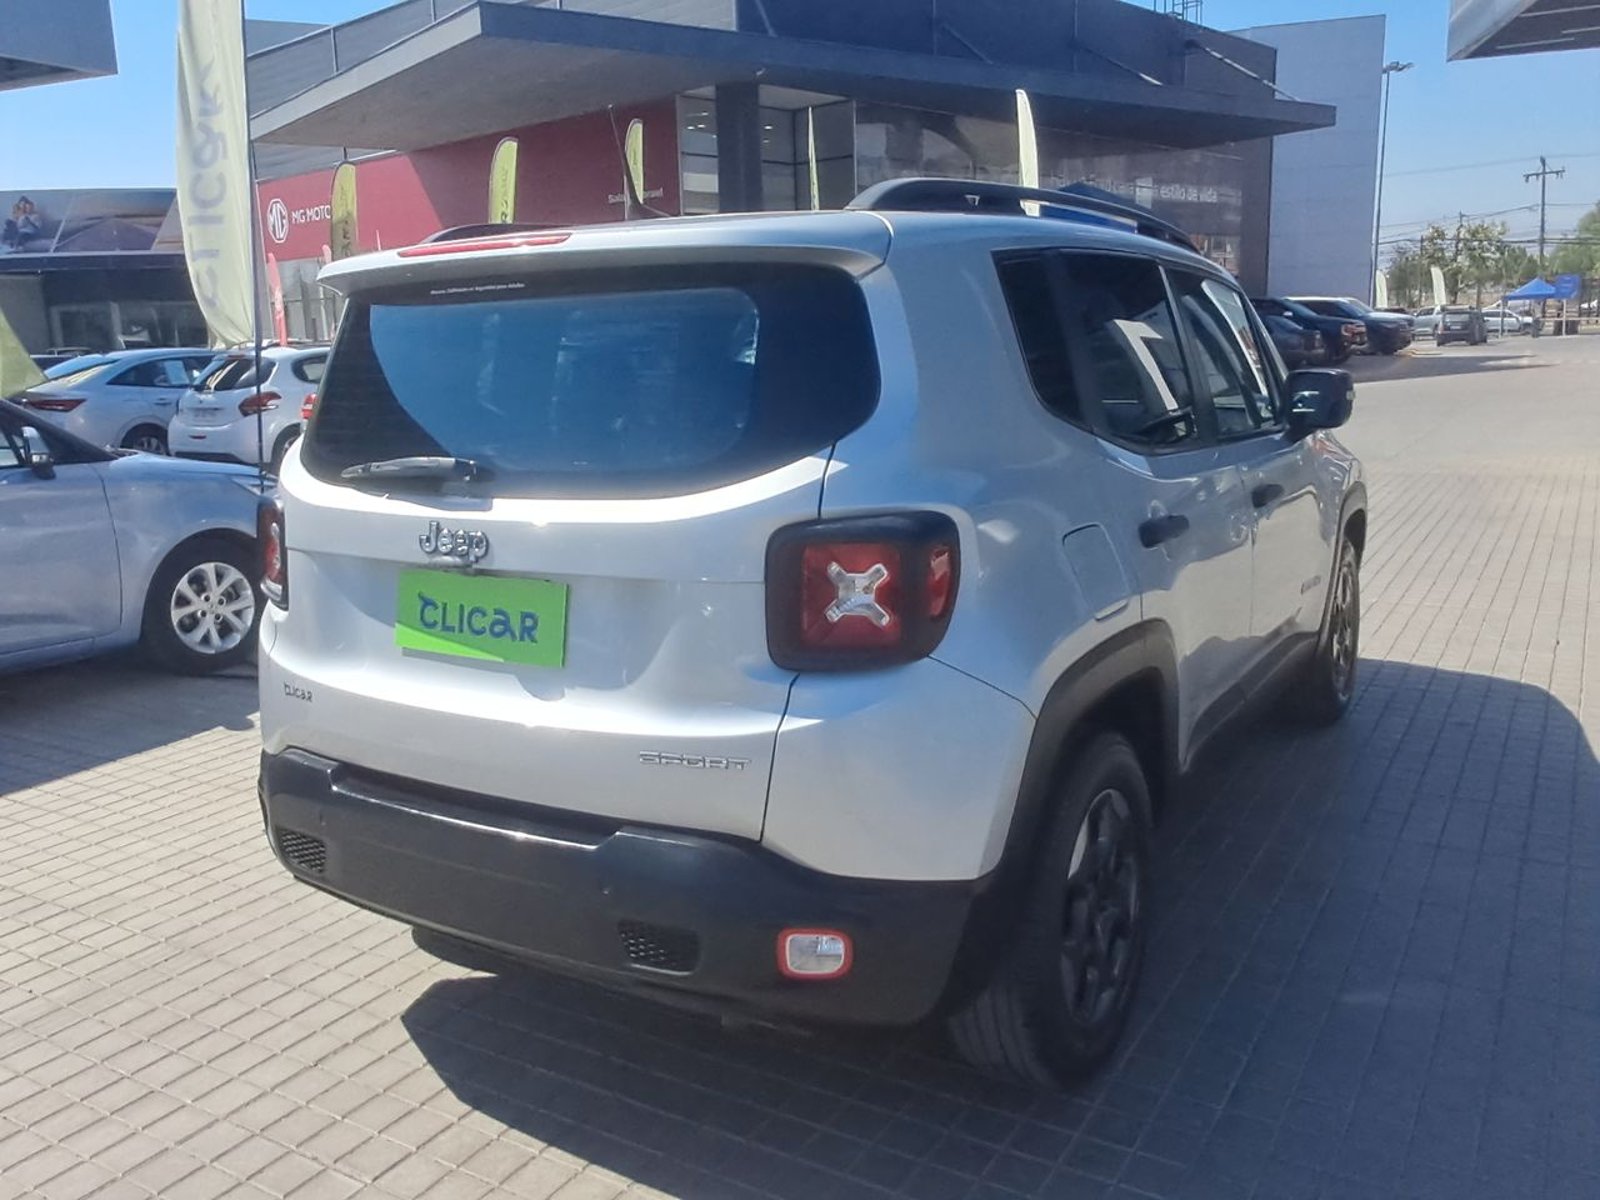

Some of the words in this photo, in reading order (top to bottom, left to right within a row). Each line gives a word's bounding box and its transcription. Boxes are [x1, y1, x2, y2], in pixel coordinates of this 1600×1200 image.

[291, 209, 306, 224] MG
[306, 205, 331, 222] MOTO
[419, 520, 489, 563] Jeep
[639, 750, 751, 770] SPORT
